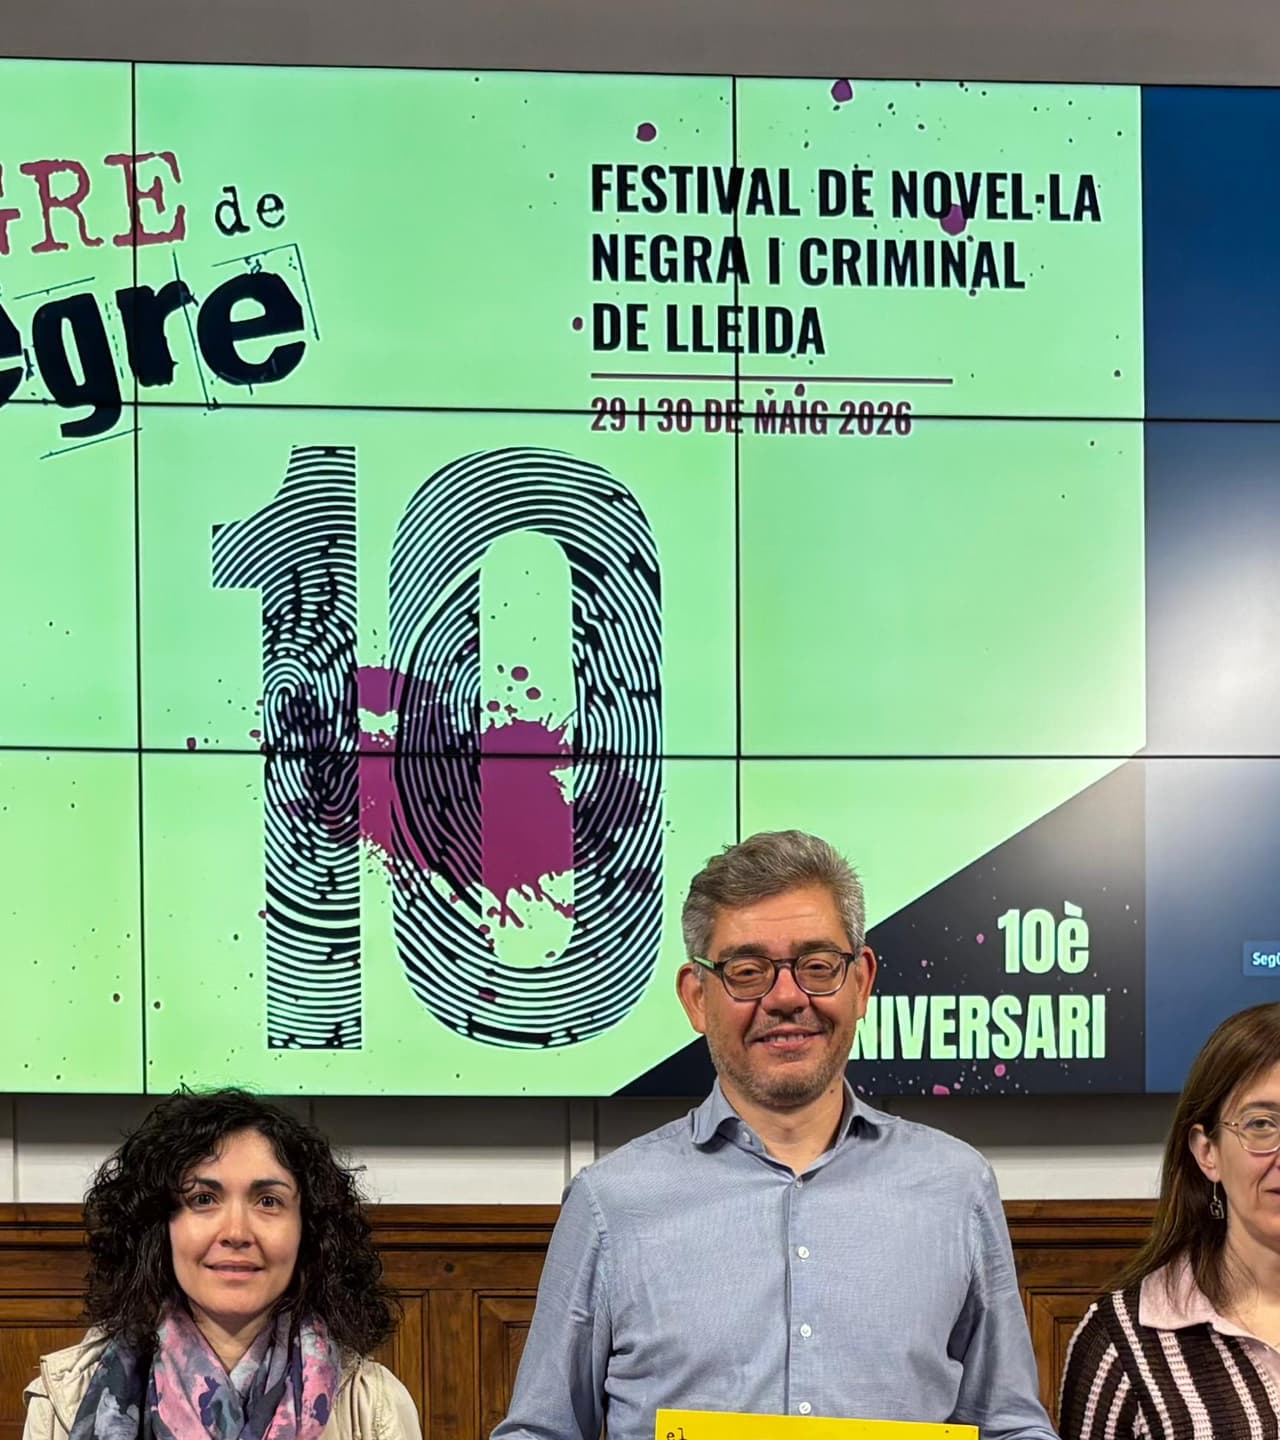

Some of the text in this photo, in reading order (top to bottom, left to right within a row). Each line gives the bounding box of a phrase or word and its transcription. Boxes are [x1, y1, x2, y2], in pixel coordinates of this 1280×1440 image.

[215, 187, 286, 235] de
[592, 164, 800, 217] FESTIVAL
[819, 169, 874, 218] DE
[592, 234, 1026, 289] NEGRA I CRIMINAL
[592, 303, 826, 354] DE LLEIDA
[591, 397, 912, 436] 29 I 30 DE MAIG 2026
[212, 445, 662, 1050] 10
[998, 901, 1090, 974] 10è
[852, 995, 1105, 1060] NIVERSARI
